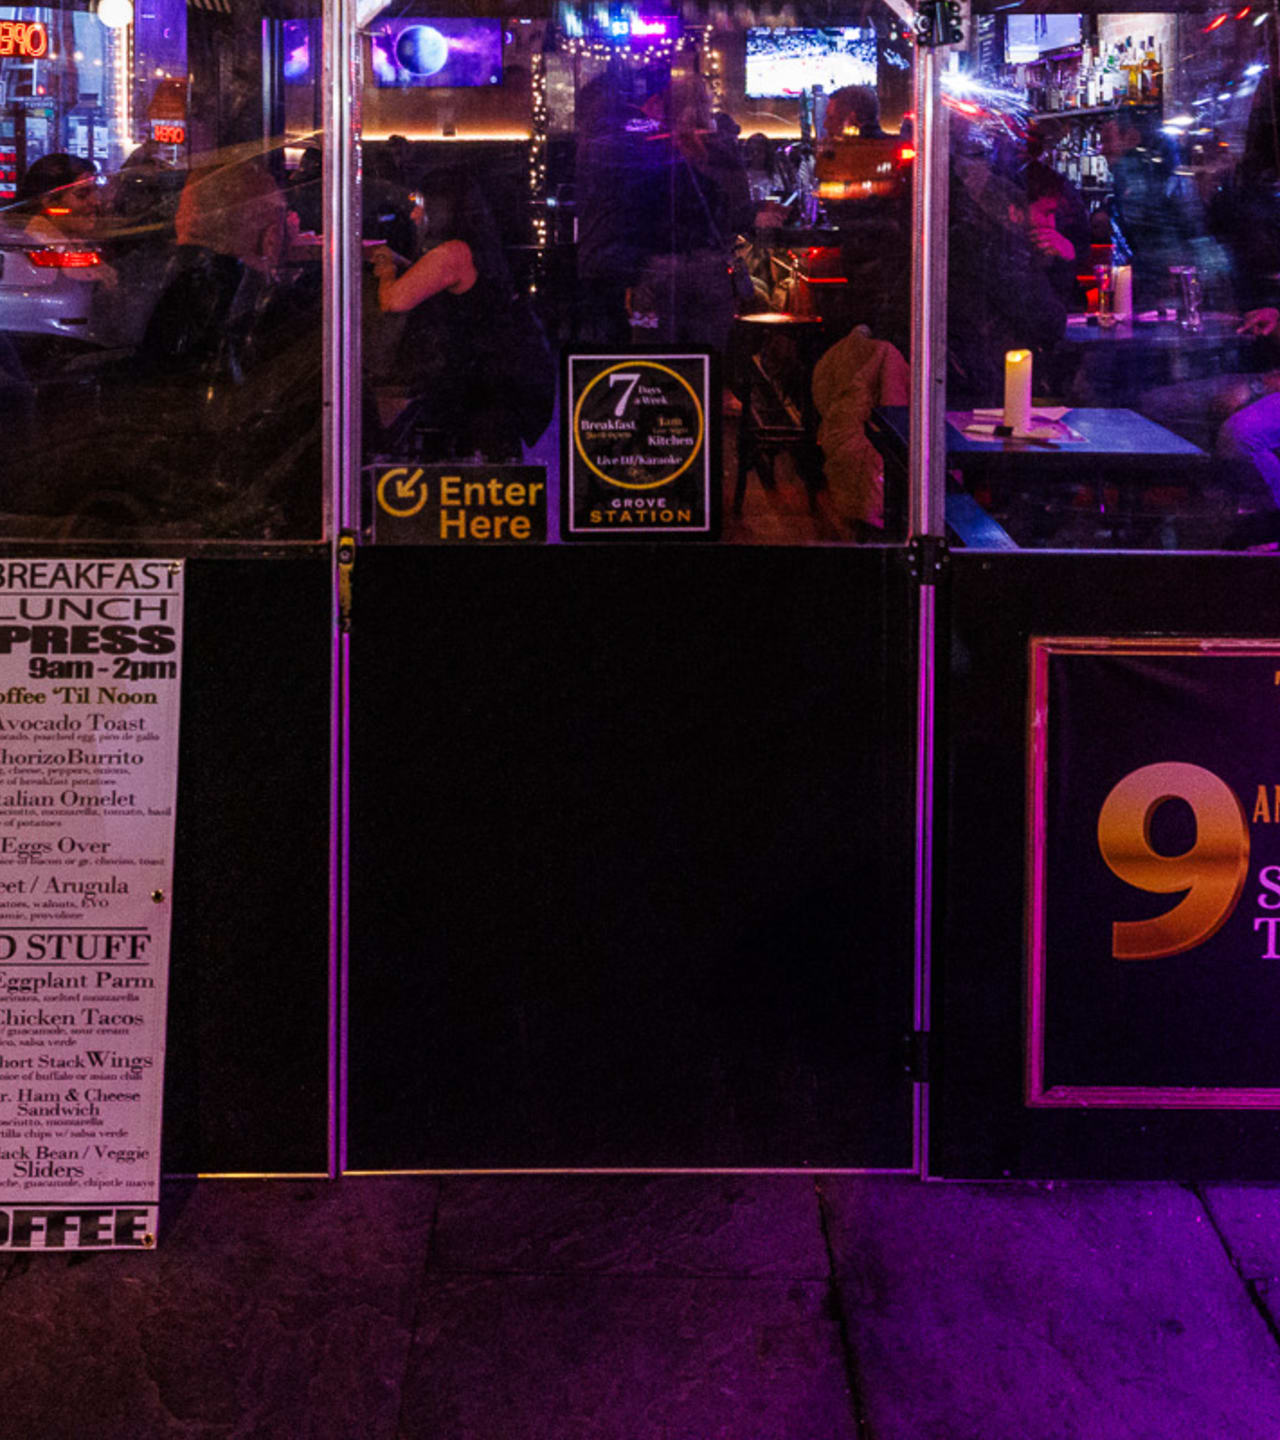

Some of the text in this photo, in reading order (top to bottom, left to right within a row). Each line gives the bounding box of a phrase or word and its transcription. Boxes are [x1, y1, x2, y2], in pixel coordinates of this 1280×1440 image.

[609, 373, 641, 417] 7
[581, 419, 637, 431] Breakfast
[648, 435, 694, 446] Kitchen
[596, 455, 619, 465] Live
[440, 476, 544, 507] Enter
[611, 498, 667, 509] GROVE
[439, 509, 532, 539] Here
[589, 510, 692, 523] STATION
[97, 687, 158, 705] Noon
[87, 713, 147, 732] Toast
[60, 790, 137, 807] Omelet
[1, 837, 53, 858] Eggs
[58, 837, 112, 854] Over
[45, 875, 130, 901] Arugula
[26, 934, 152, 961] STUFF
[96, 971, 156, 989] Parm
[81, 1008, 145, 1026] Tacos
[17, 1089, 60, 1103] Ham
[65, 1089, 80, 1103] &
[84, 1089, 141, 1103] Cheese
[17, 1103, 101, 1117] Sandwich
[36, 1146, 79, 1160] Bean
[94, 1145, 150, 1164] Veggie
[13, 1161, 86, 1178] Sliders
